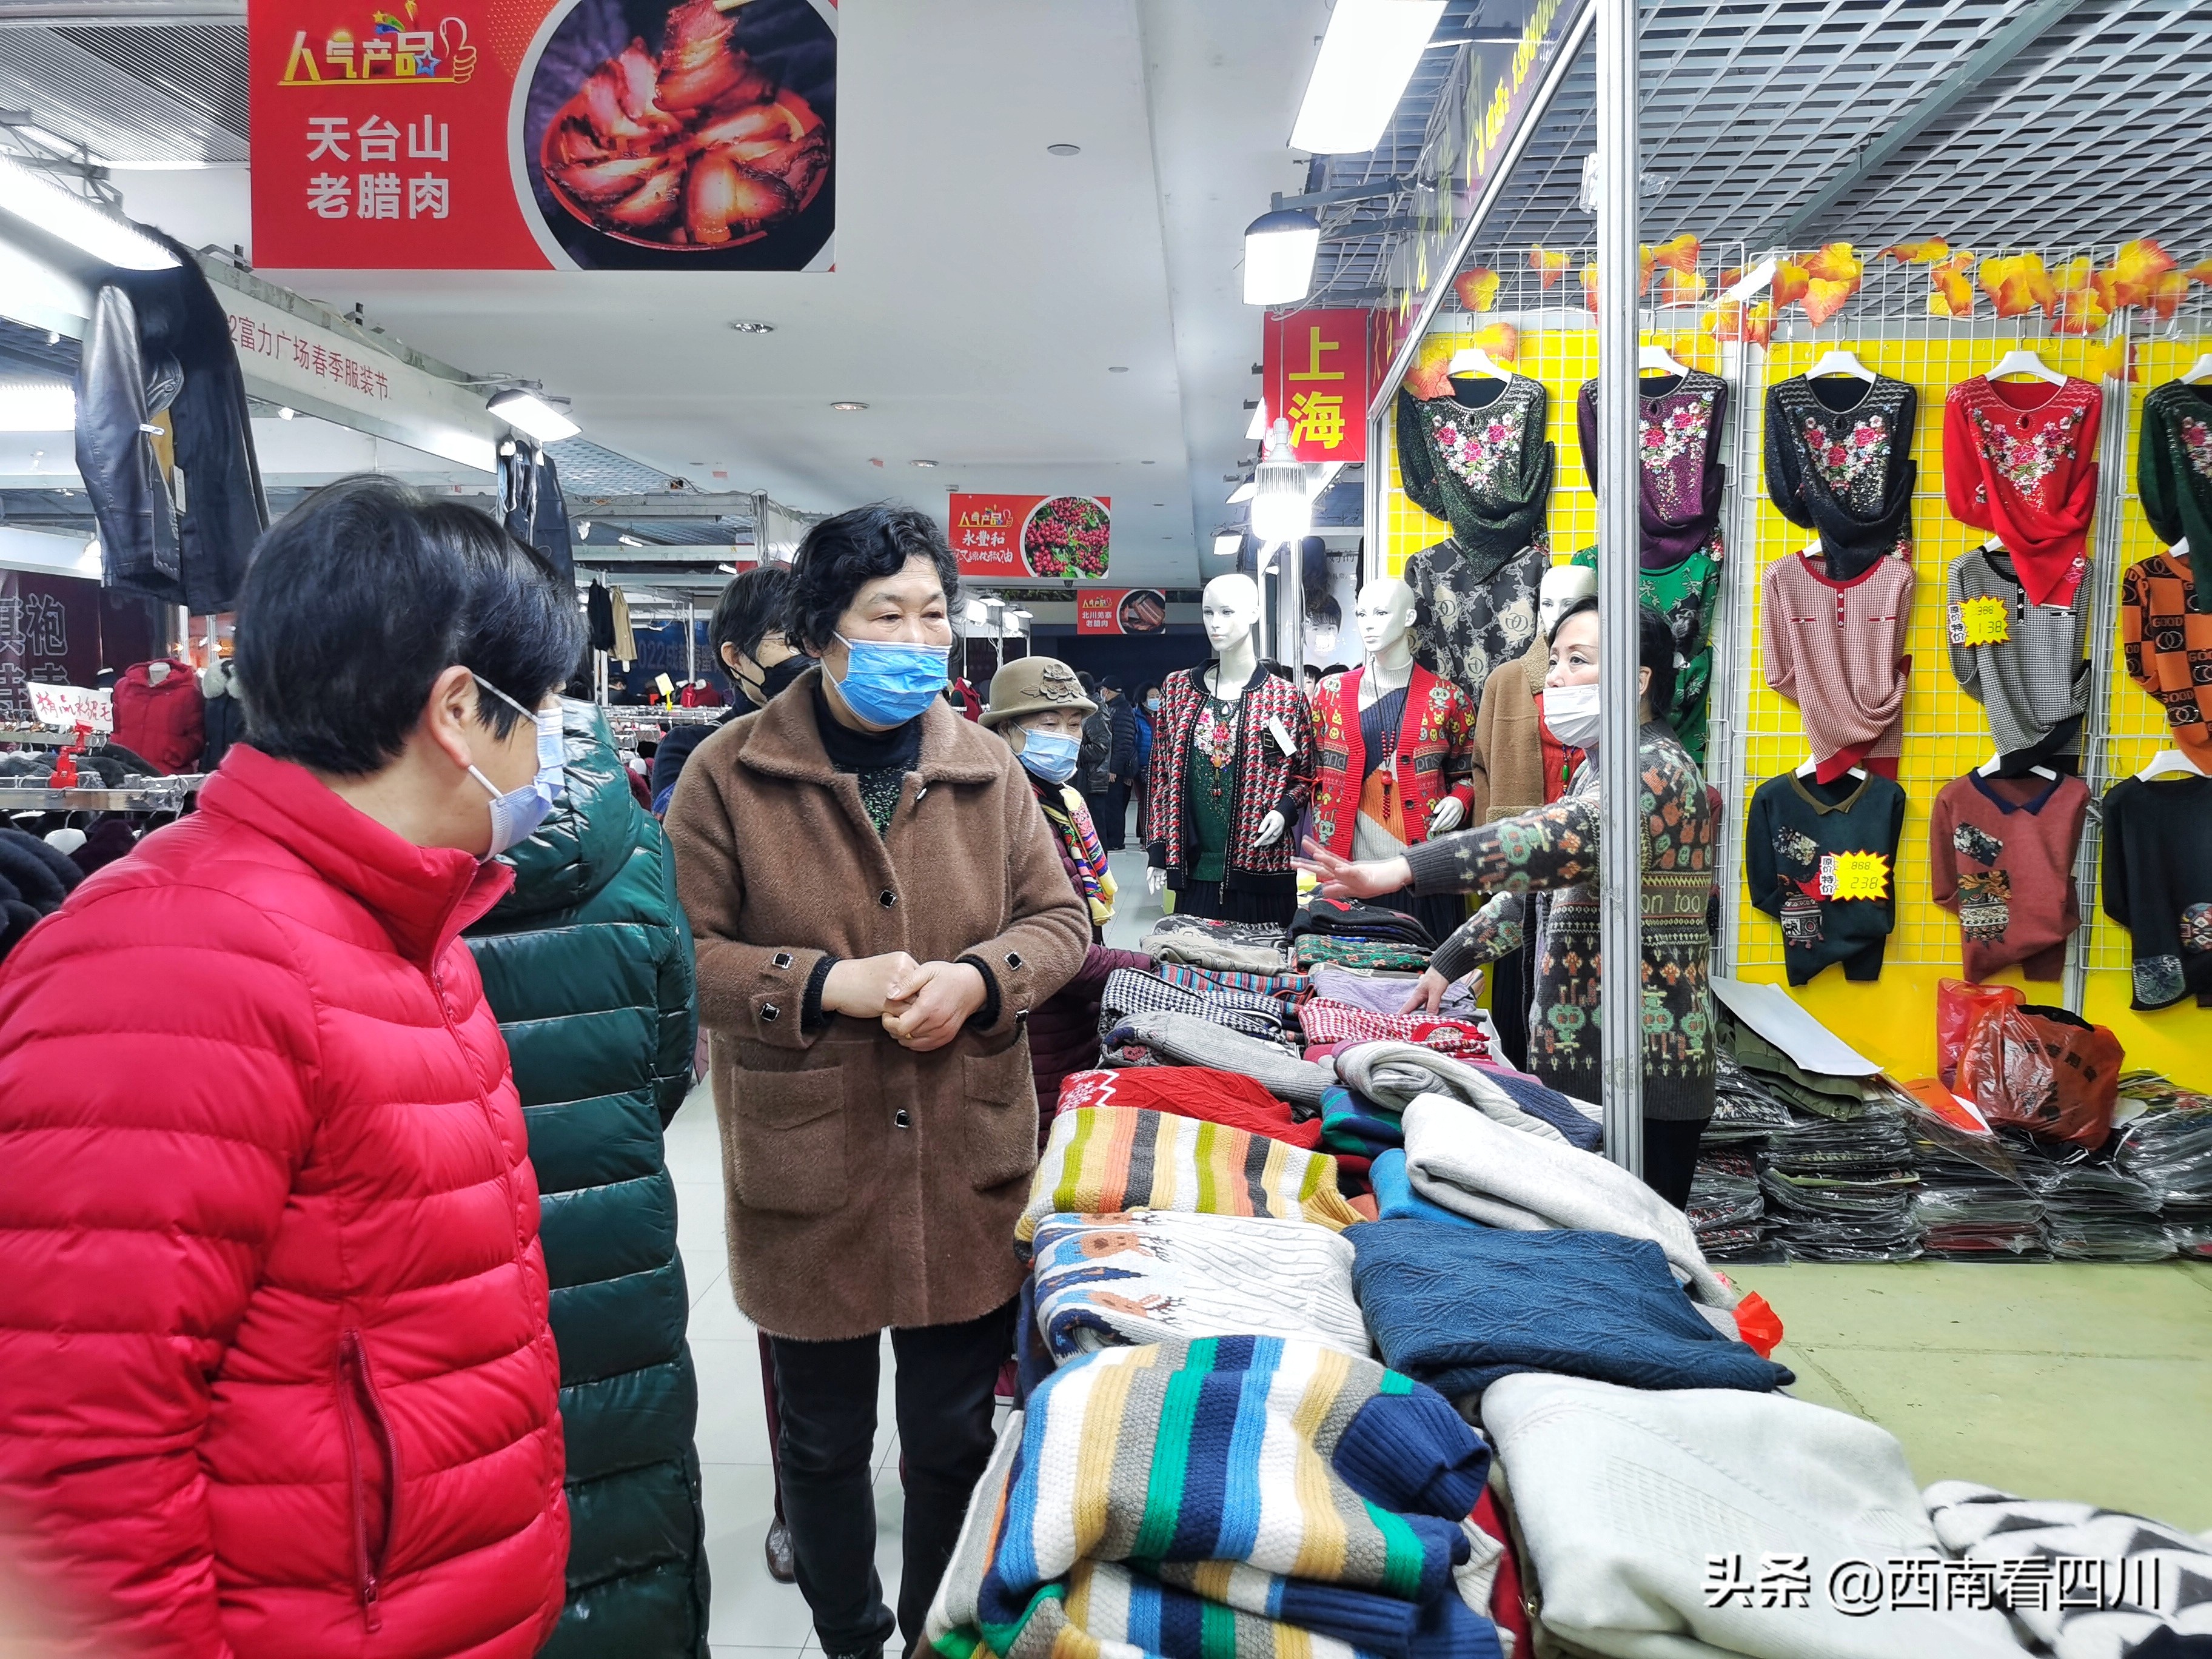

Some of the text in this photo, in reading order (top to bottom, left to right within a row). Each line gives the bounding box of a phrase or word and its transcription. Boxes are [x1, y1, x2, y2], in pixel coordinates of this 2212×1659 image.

[283, 30, 434, 81] 人气产品
[306, 115, 449, 162] 天台山
[306, 172, 449, 220] 老腊肉
[1288, 326, 1345, 449] 上海
[2153, 617, 2183, 628] GOOD
[1851, 876, 1879, 889] 238
